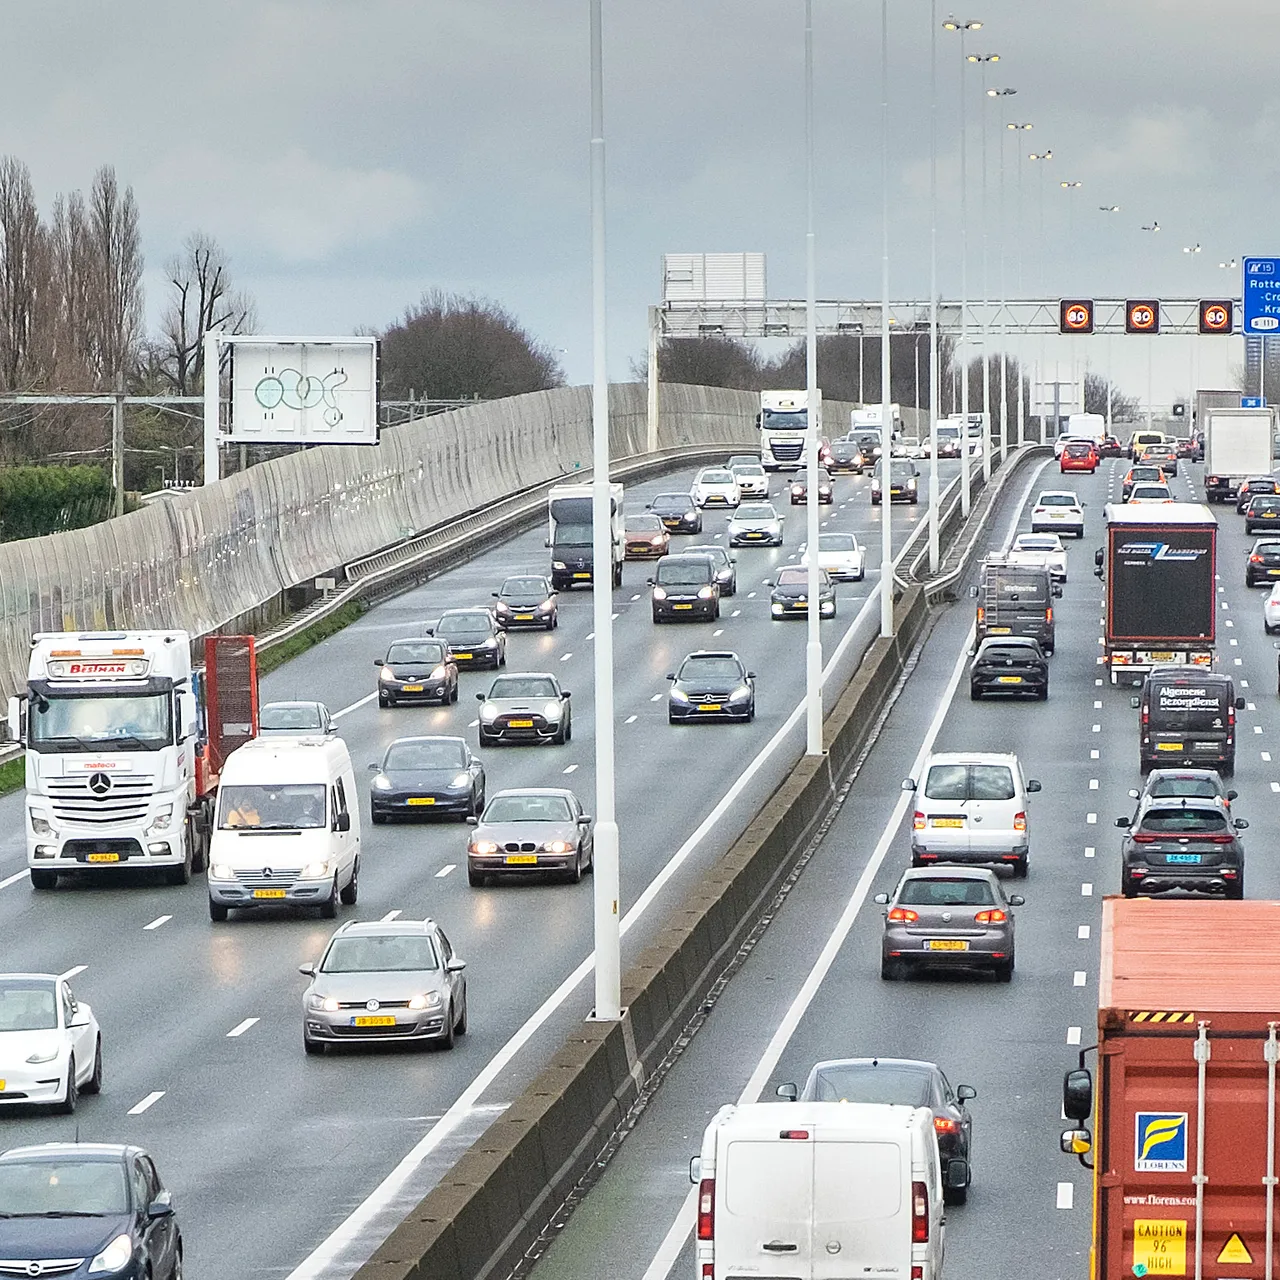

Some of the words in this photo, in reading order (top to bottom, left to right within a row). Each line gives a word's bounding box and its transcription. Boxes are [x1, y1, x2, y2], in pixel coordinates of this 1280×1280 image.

[1068, 311, 1084, 321] 80
[1132, 311, 1149, 321] 80
[1207, 311, 1225, 321] 80
[1159, 687, 1206, 697] Algemene
[1159, 697, 1220, 707] Bezorgdienst
[1137, 1161, 1185, 1170] FLORENS
[1138, 1224, 1183, 1237] CAUTION
[1147, 1257, 1172, 1269] HIGH
